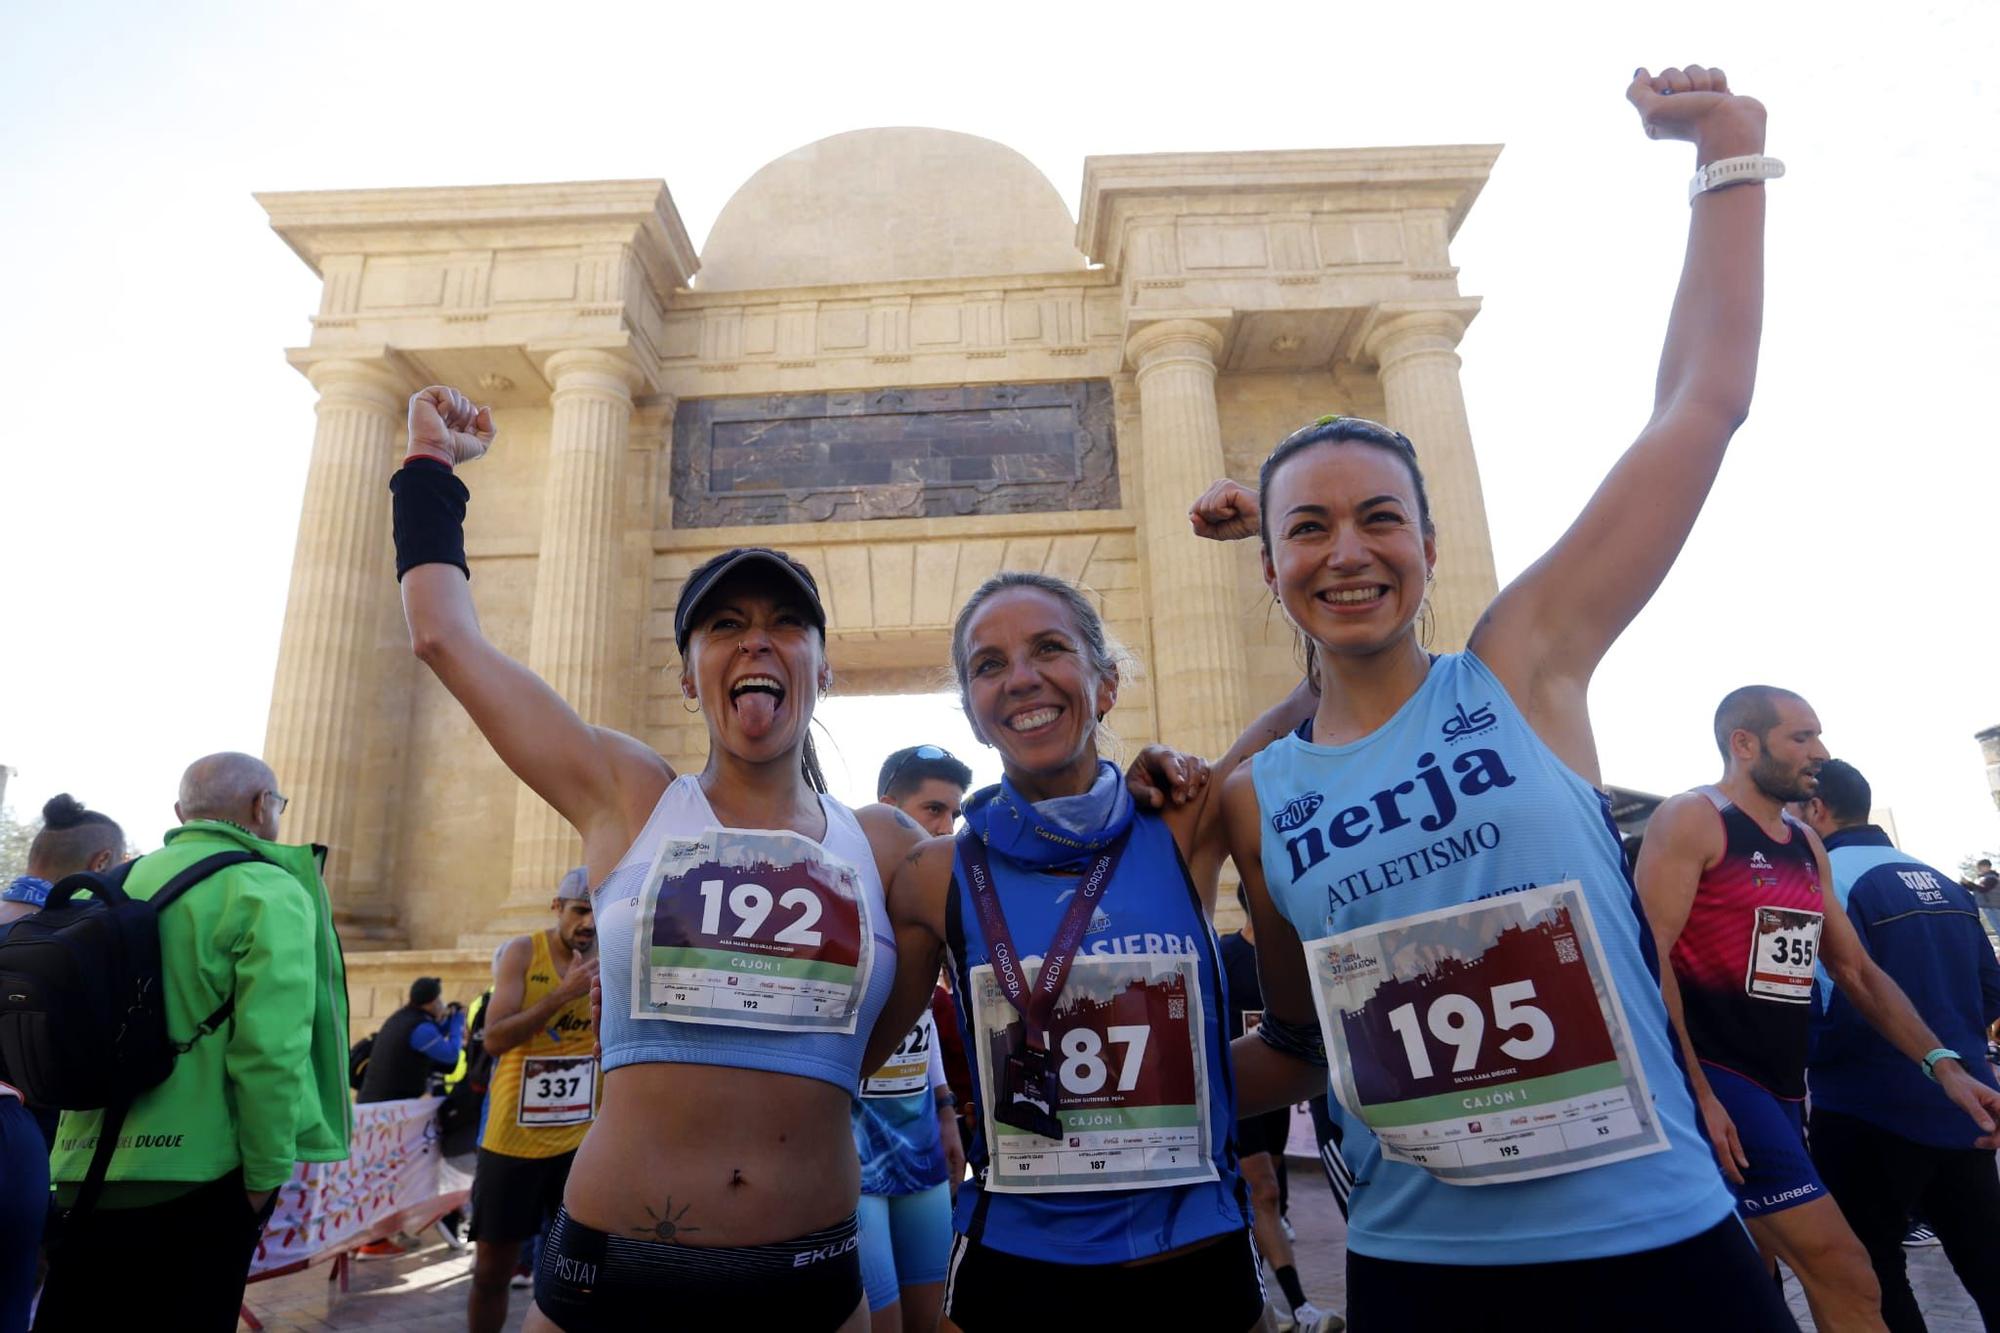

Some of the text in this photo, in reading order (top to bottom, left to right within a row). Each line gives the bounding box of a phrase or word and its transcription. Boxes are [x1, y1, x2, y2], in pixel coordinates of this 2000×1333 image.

[1285, 748, 1517, 885] nerja
[1326, 821, 1501, 913] ATLETISMO
[971, 864, 986, 893] MEDIA
[700, 880, 823, 947] 192
[1771, 936, 1813, 967] 355
[731, 956, 772, 972] CAJÓN
[1044, 955, 1065, 993] MEDIA
[675, 993, 686, 1001] 192
[743, 1000, 758, 1009] 192
[554, 1009, 592, 1031] Álor
[1388, 979, 1555, 1080] 195
[537, 1077, 581, 1098] 337
[1463, 1089, 1515, 1110] CAJÓN
[1068, 1113, 1112, 1127] CAJÓN
[135, 1134, 184, 1148] DUQUE
[1499, 1145, 1520, 1158] 195
[1019, 1163, 1030, 1171] 187
[1090, 1160, 1106, 1170] 187
[1413, 1154, 1428, 1163] 195
[1762, 1183, 1818, 1206] LURBEL
